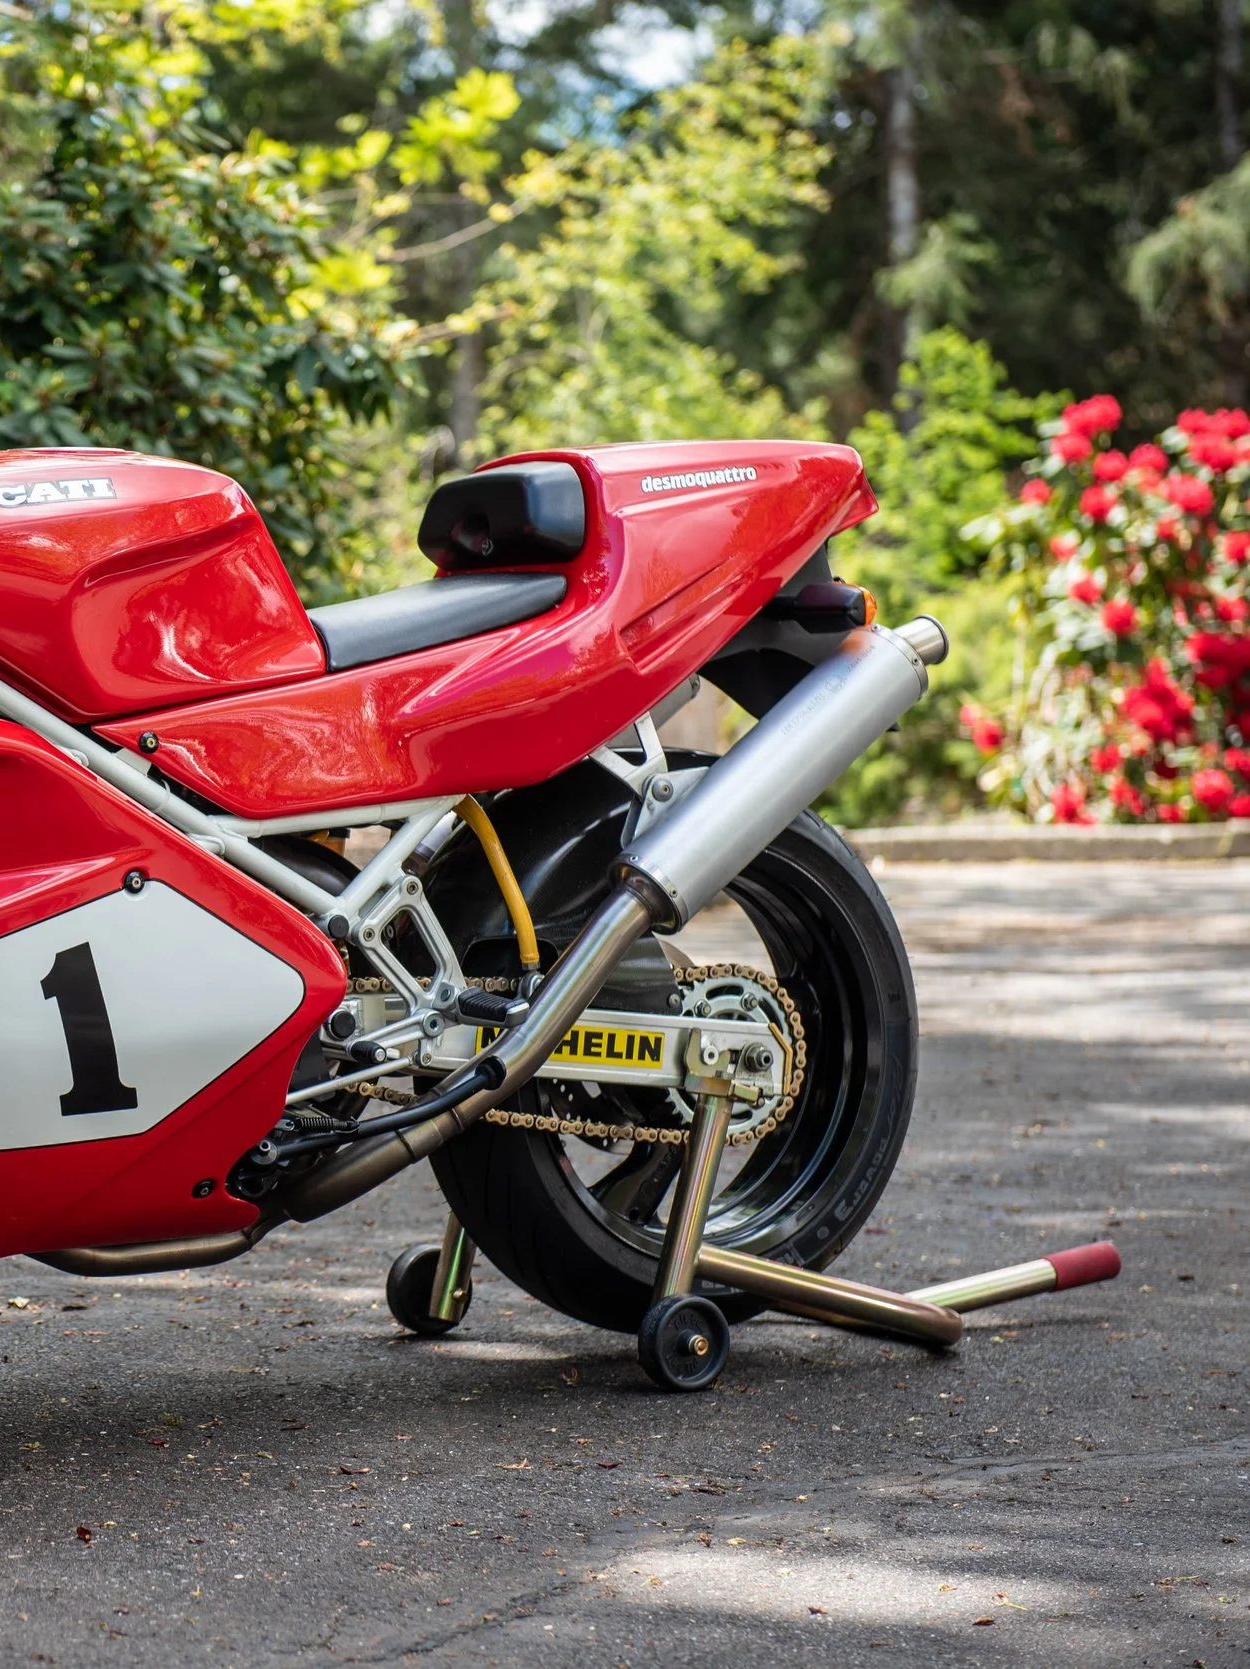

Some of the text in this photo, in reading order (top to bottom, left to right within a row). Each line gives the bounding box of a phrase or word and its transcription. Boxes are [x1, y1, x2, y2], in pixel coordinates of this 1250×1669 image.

[641, 466, 757, 493] desmoquattro
[40, 941, 138, 1116] 1
[481, 1026, 662, 1062] MHELIN
